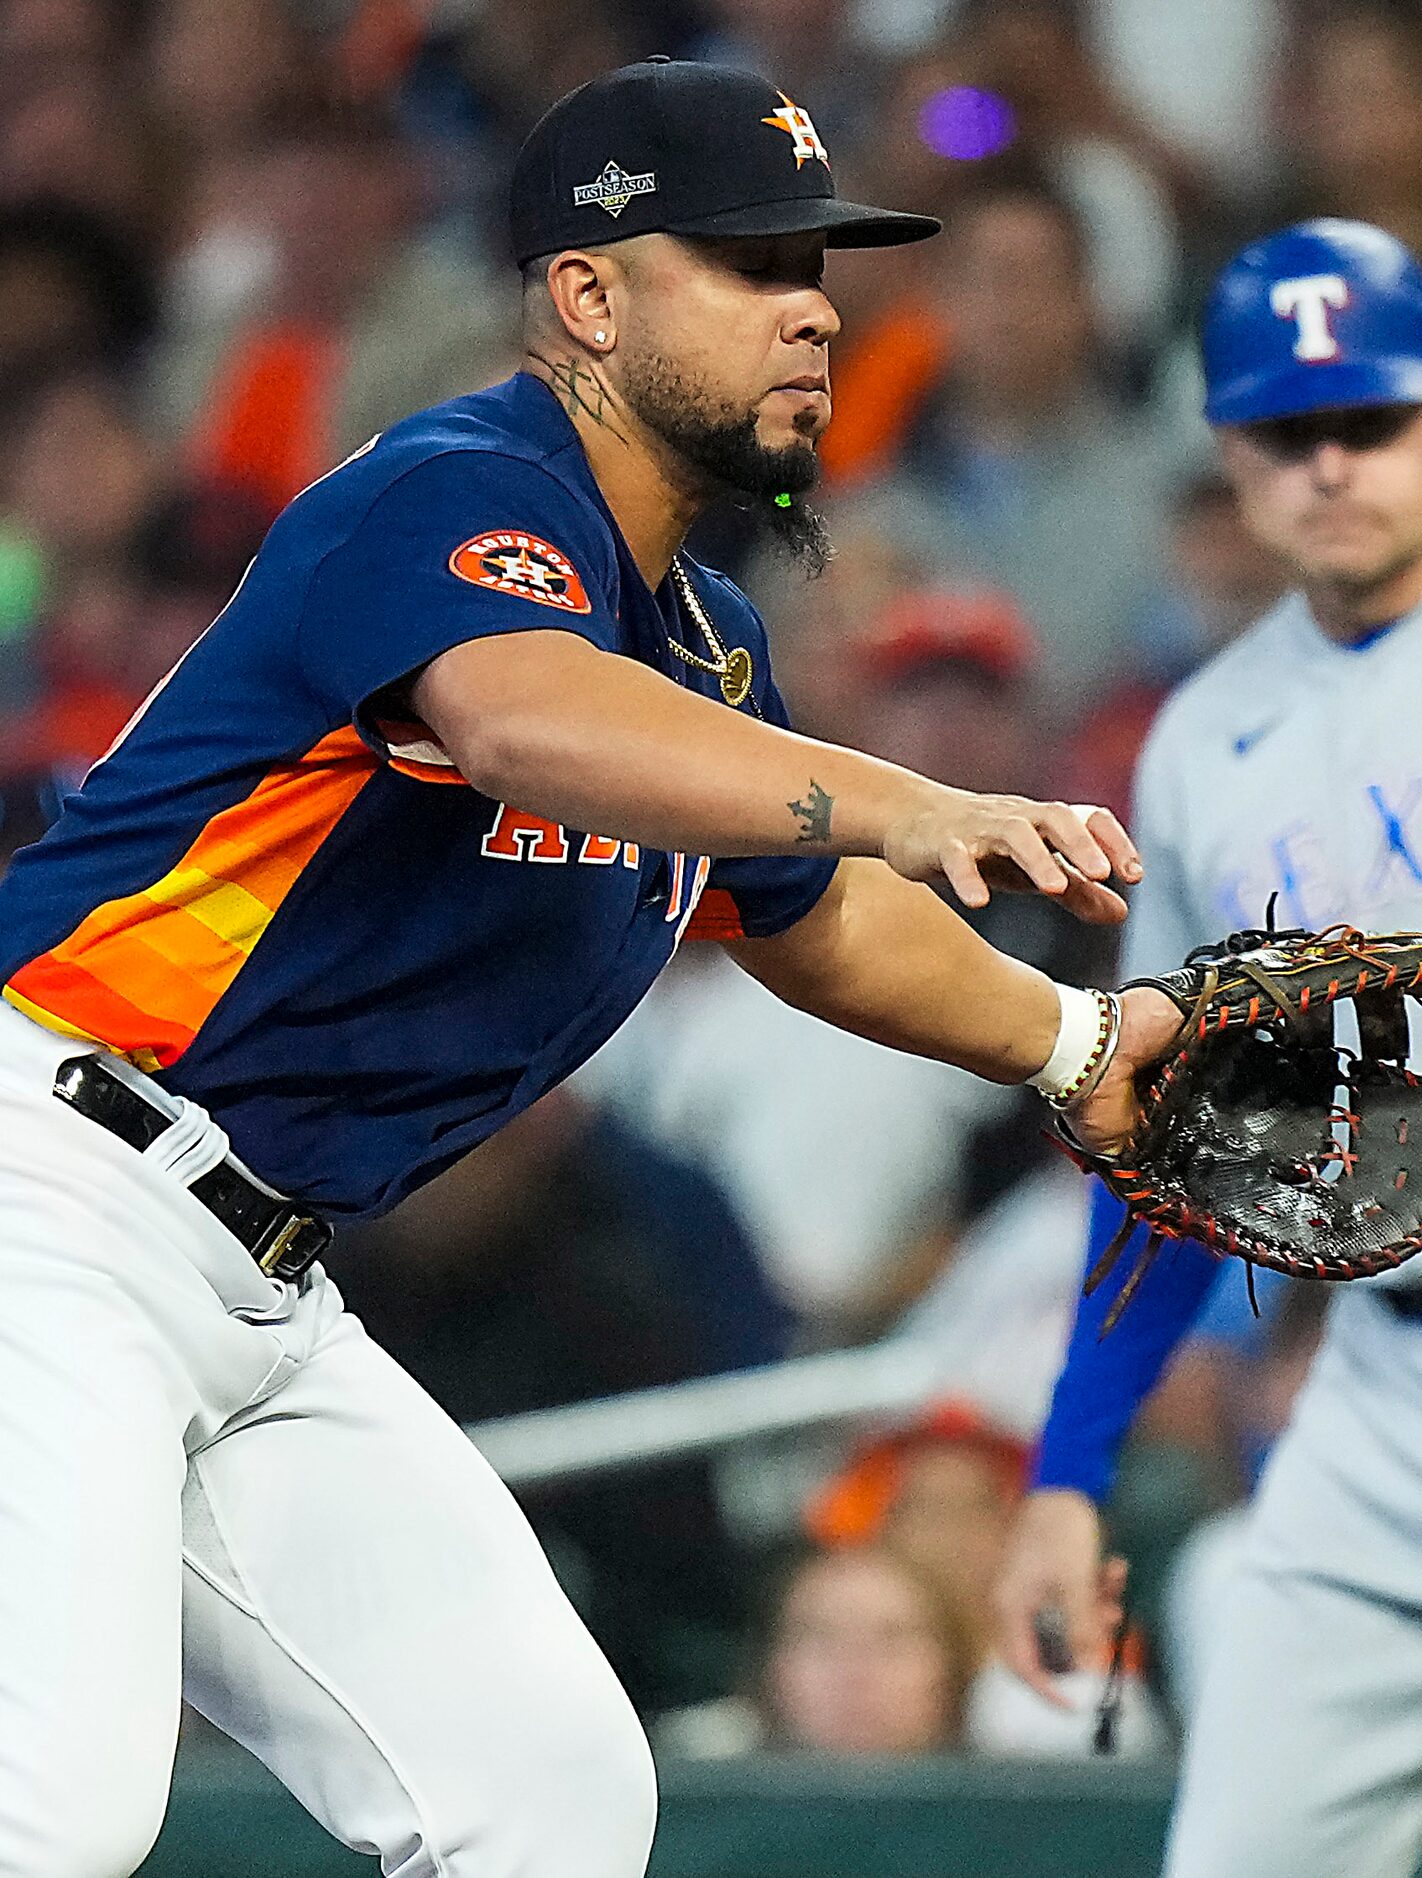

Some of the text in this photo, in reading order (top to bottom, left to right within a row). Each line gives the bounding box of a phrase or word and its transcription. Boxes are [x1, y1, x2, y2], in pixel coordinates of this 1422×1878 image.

[772, 106, 828, 160] H
[574, 177, 655, 201] POSTSEASON
[1269, 272, 1351, 367] T
[467, 534, 575, 577] HOUSTON
[498, 554, 553, 593] H
